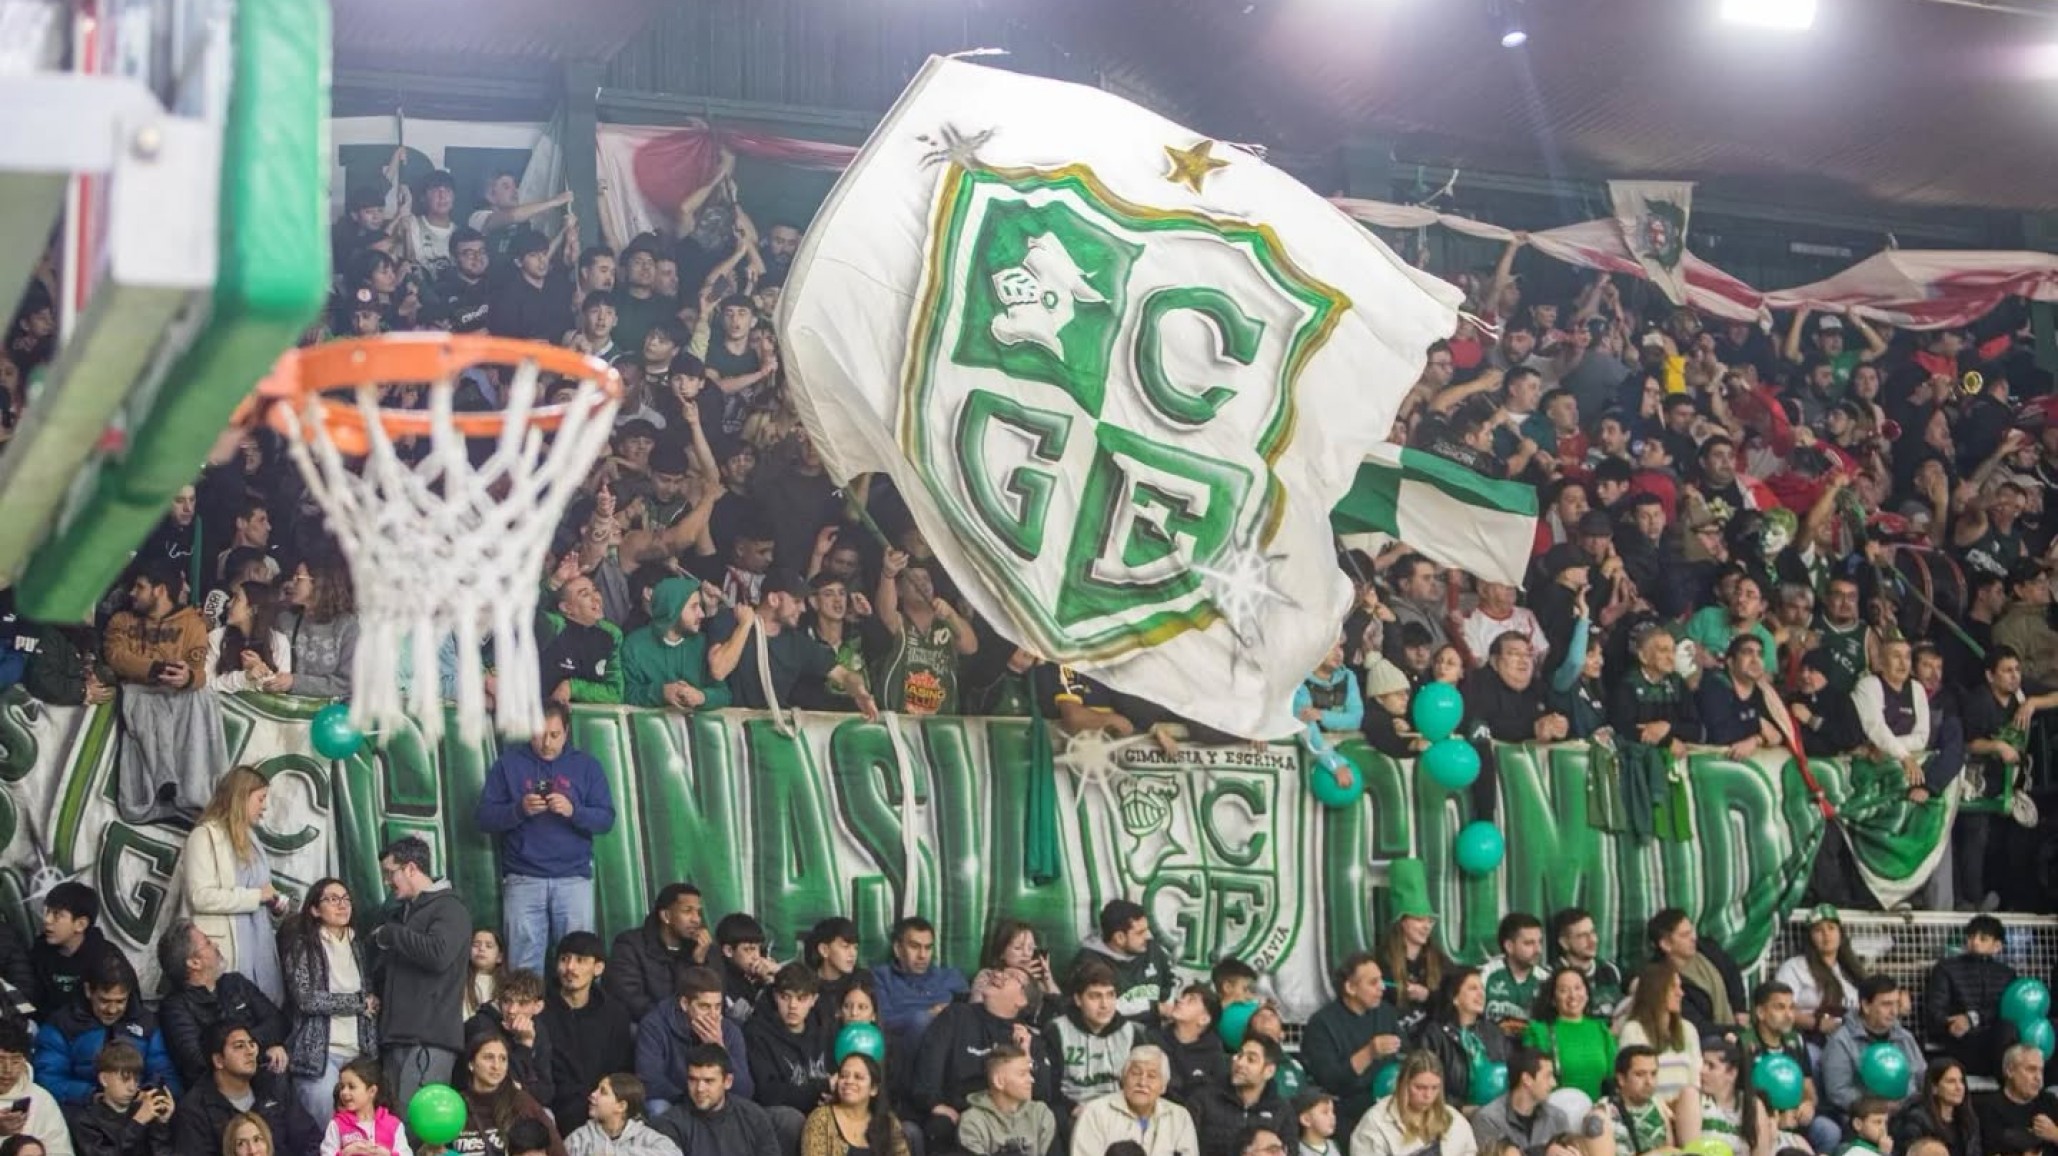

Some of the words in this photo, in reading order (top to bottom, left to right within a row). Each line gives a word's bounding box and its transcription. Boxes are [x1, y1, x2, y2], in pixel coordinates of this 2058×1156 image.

[1133, 286, 1266, 426] C
[955, 388, 1074, 562] G
[1085, 451, 1211, 586] E
[905, 683, 946, 700] ASINO
[1206, 750, 1218, 765] Y
[1224, 751, 1297, 771] ESGRIMA
[1201, 776, 1267, 866] C
[1143, 873, 1203, 961] G
[1253, 926, 1290, 973] DAVIA
